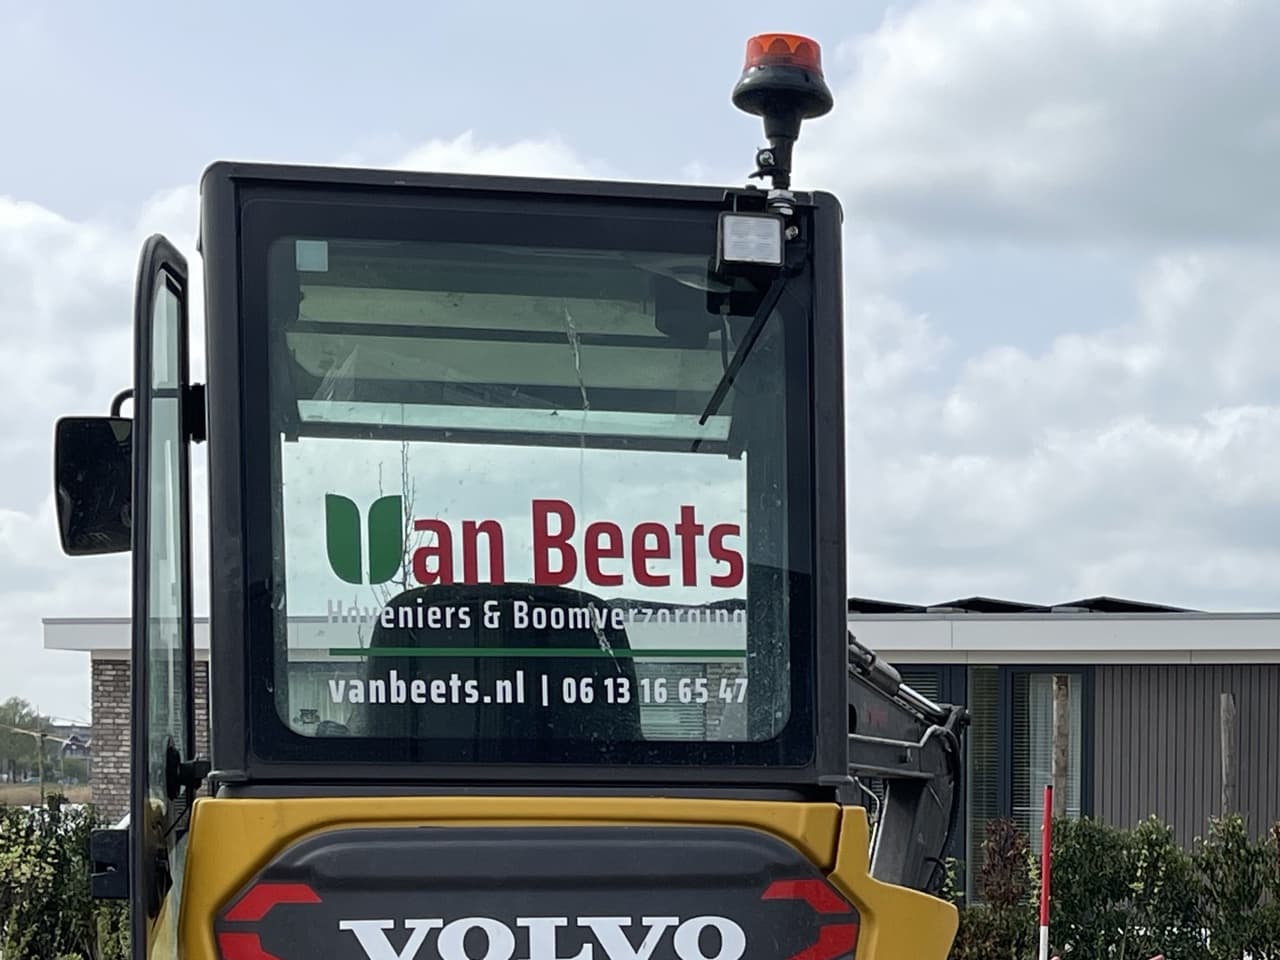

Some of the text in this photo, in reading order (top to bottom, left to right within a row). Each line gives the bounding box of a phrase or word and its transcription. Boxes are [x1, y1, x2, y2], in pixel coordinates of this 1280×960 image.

[532, 499, 744, 588] Beets
[483, 600, 501, 629] &
[328, 670, 525, 703] vanbeets.nl
[562, 677, 594, 703] 06
[604, 677, 631, 703] 13
[640, 678, 668, 703] 16
[678, 678, 708, 703] 65
[718, 678, 748, 703] 47
